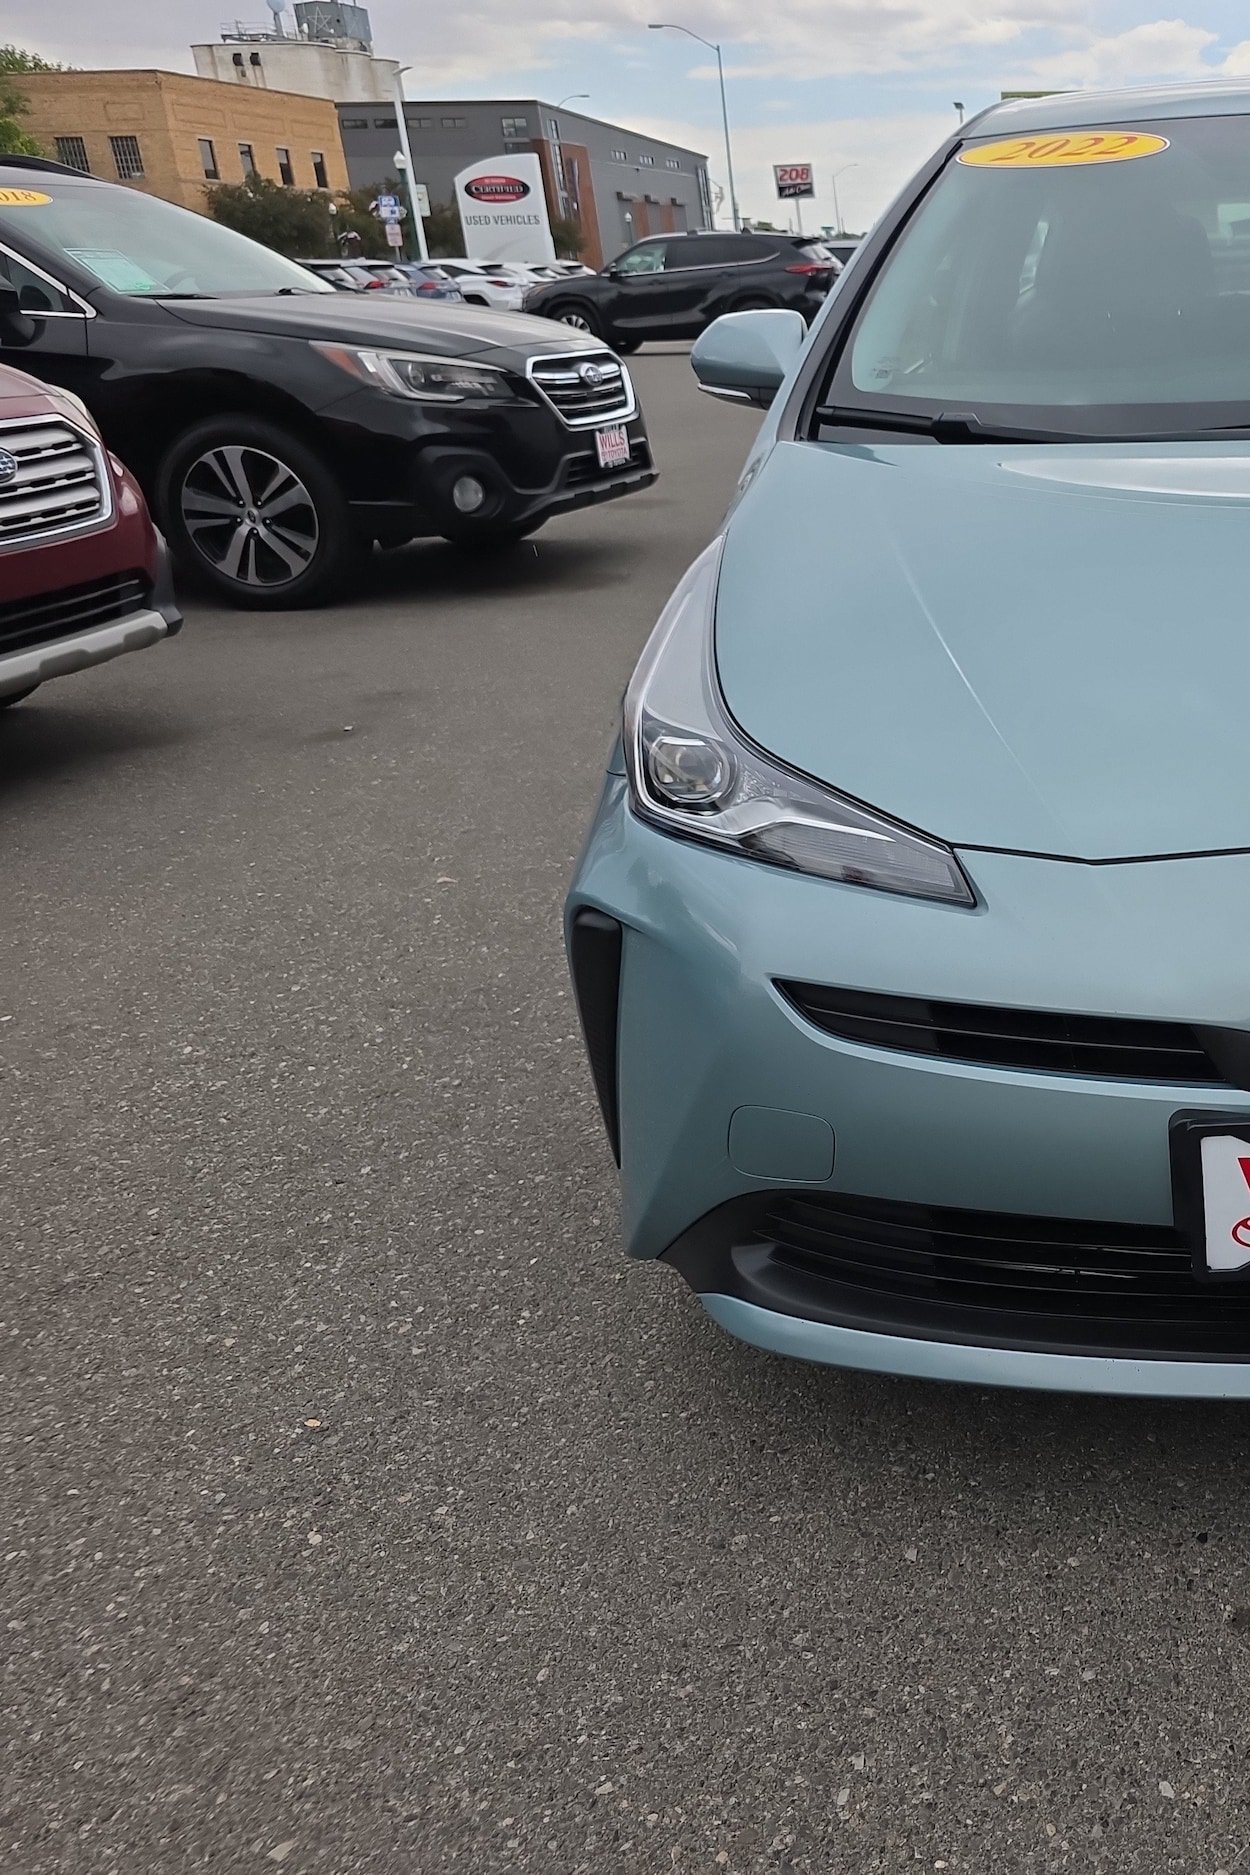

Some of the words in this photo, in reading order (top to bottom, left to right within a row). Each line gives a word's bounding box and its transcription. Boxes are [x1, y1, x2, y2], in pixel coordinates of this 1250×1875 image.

[989, 136, 1138, 162] 2022
[779, 167, 809, 182] 208
[464, 215, 491, 226] USED
[491, 214, 541, 225] VEHICLES
[600, 431, 625, 450] WILLS
